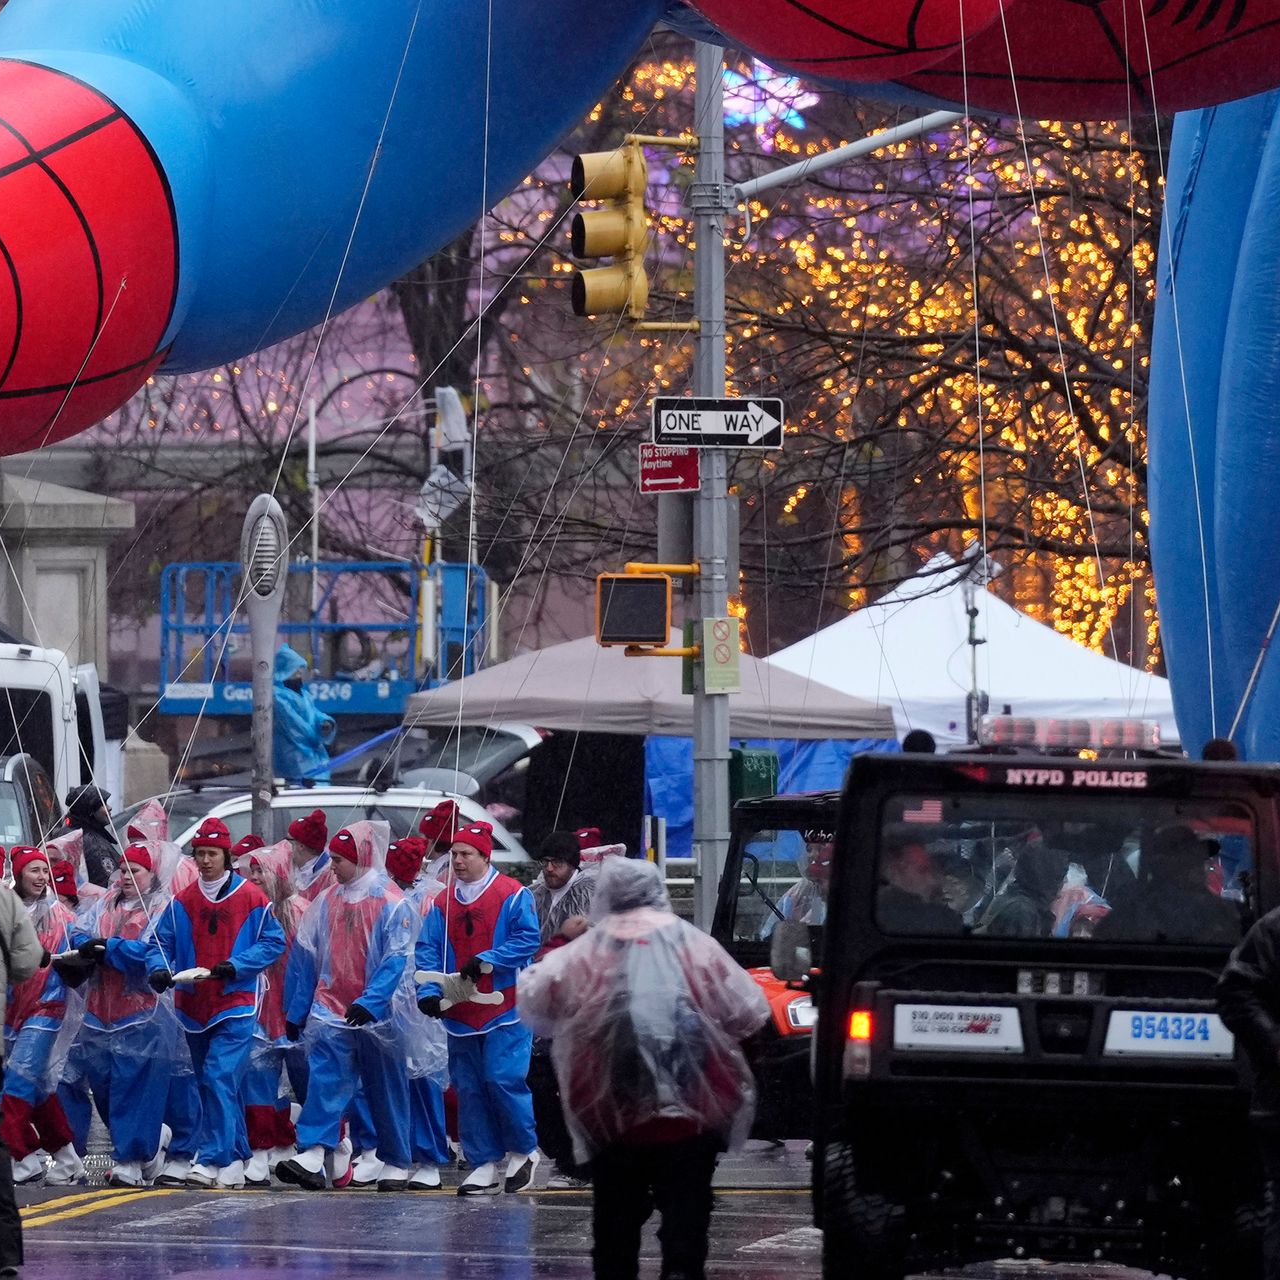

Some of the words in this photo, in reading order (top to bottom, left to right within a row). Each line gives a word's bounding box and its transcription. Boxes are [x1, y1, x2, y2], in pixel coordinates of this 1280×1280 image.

[665, 413, 702, 431] ONE
[724, 414, 763, 432] WAY
[642, 447, 653, 458] NO
[654, 446, 689, 457] STOPPING
[643, 459, 673, 470] Anytime
[223, 684, 253, 701] Gen
[1006, 769, 1065, 786] NYPD
[1072, 770, 1148, 788] POLICE
[1131, 1015, 1209, 1041] 954324
